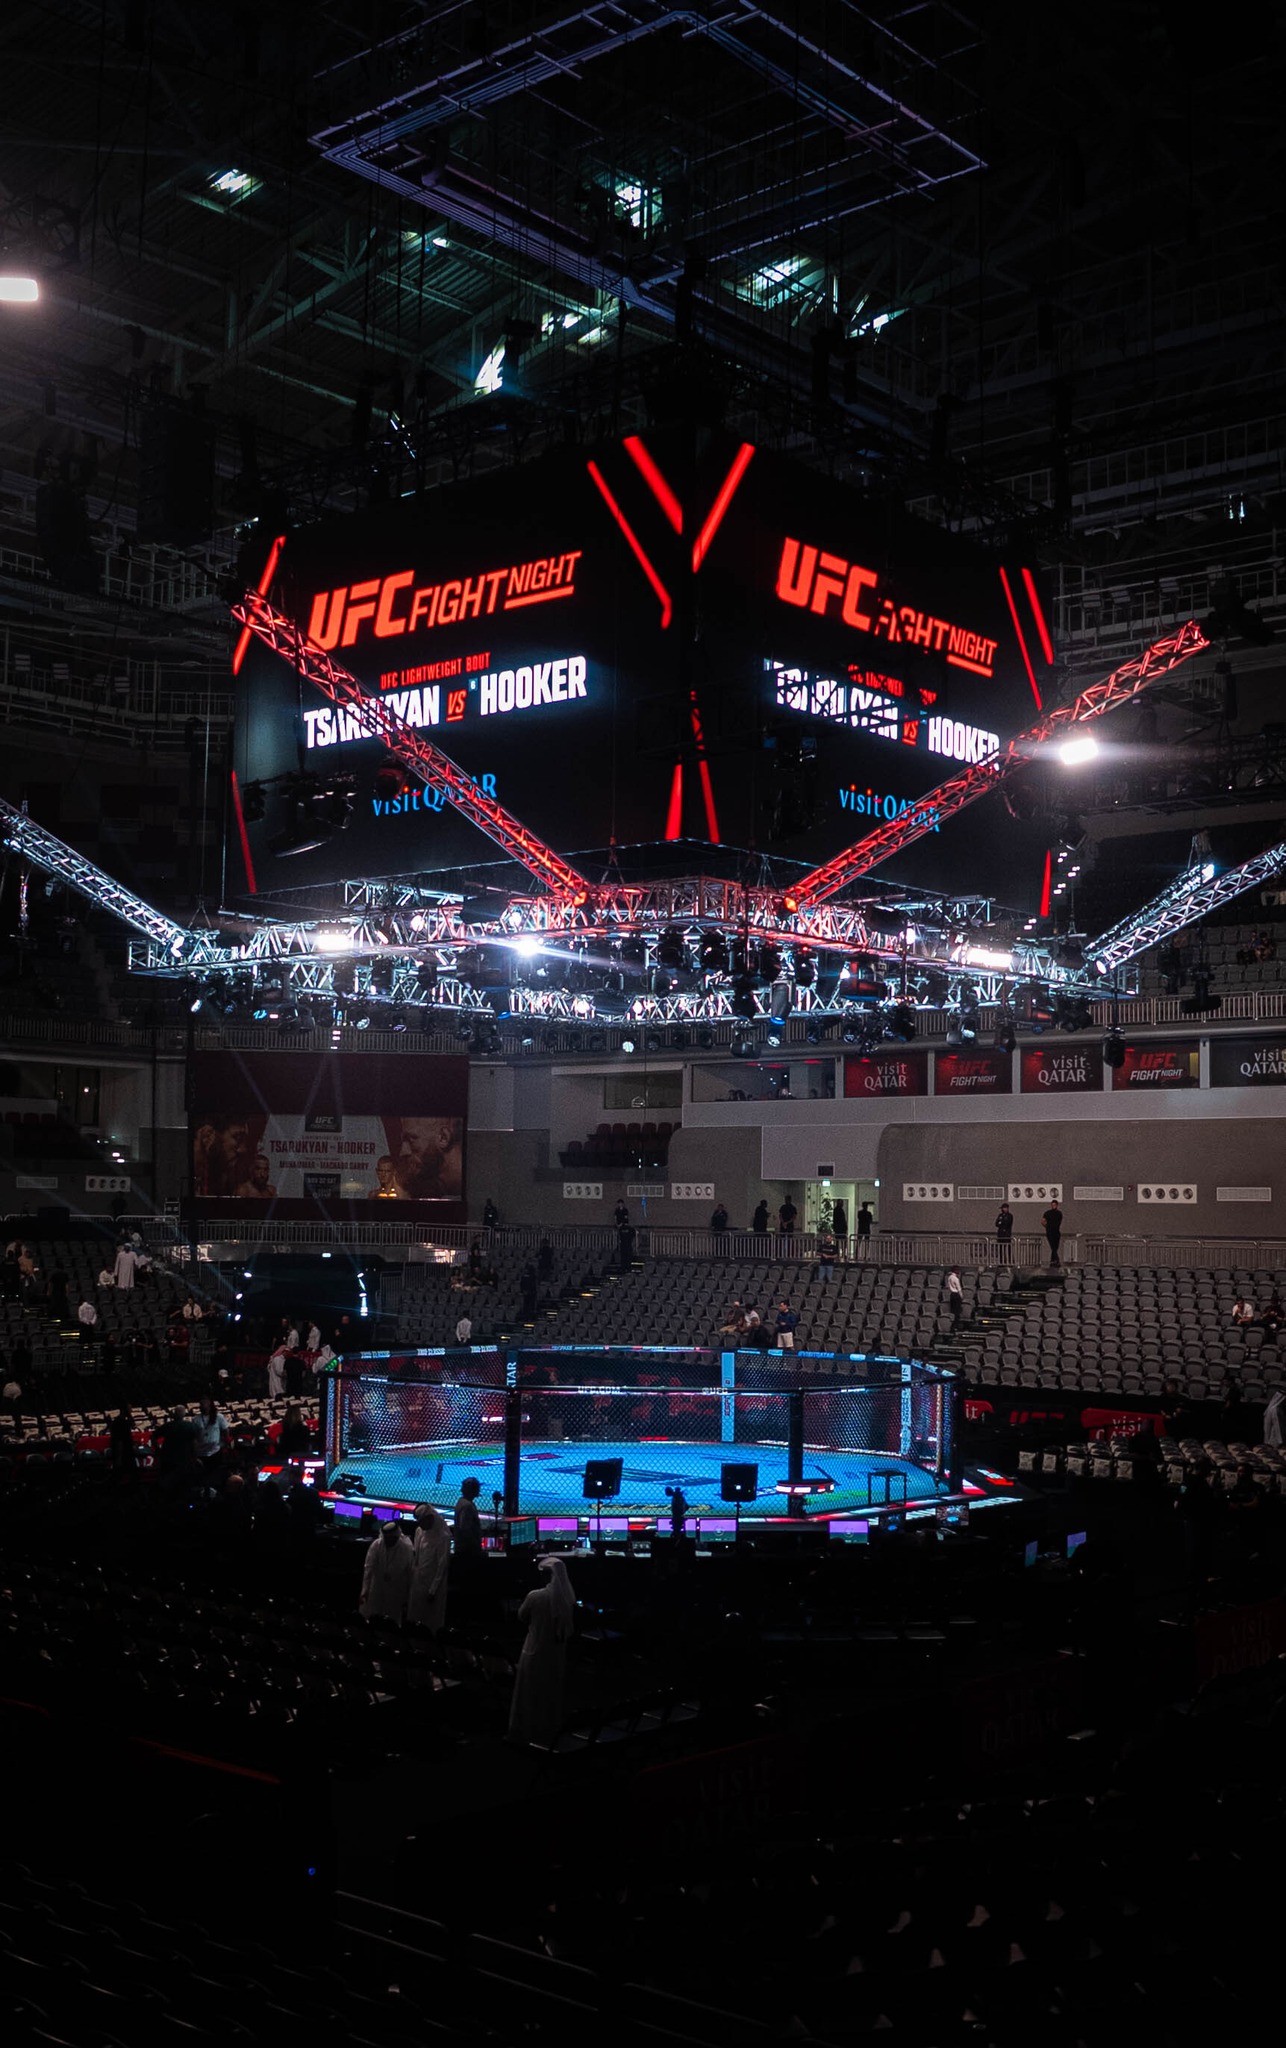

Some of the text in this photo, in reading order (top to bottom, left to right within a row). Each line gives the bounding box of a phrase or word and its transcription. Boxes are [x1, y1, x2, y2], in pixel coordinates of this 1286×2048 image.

[307, 551, 582, 650] UFC FIGHT NIGHT
[776, 536, 878, 632] UFC
[948, 625, 998, 665] NIGHT
[380, 652, 491, 690] UFC LIGHTWEIGHT BOUT
[447, 689, 467, 716] VS
[480, 655, 587, 716] HOOKER
[903, 719, 919, 739] VS
[954, 1060, 991, 1075] UFC
[1052, 1055, 1086, 1068] visit
[1140, 1053, 1176, 1068] UFC
[877, 1062, 907, 1076] visit
[1130, 1069, 1184, 1081] FIGHT NIGHT
[864, 1075, 907, 1090] QATAR
[950, 1075, 998, 1087] FIGHT NIGHT
[1038, 1069, 1086, 1085] QATAR
[314, 1116, 334, 1124] UFC
[270, 1140, 328, 1154] TSARUKYAN
[337, 1141, 376, 1155] HOOKER
